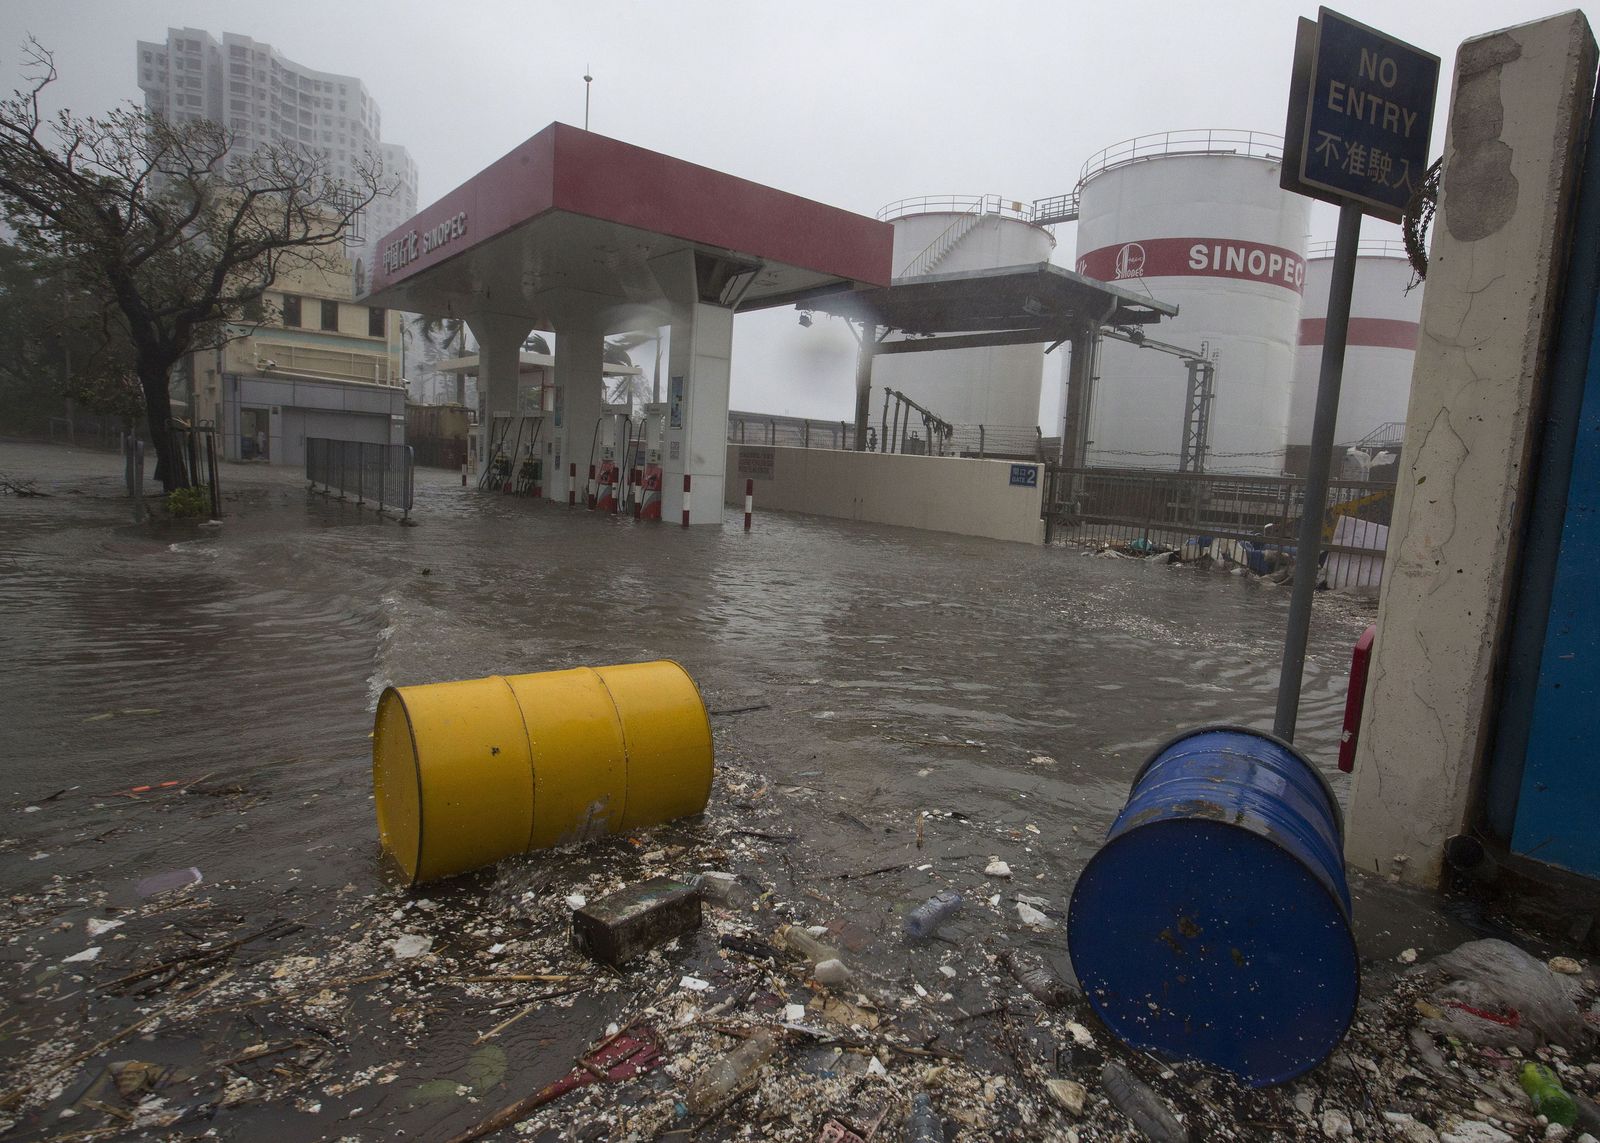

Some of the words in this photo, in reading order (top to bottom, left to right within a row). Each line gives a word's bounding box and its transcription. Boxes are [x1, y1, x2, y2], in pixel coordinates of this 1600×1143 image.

[1359, 48, 1398, 88] NO
[1328, 80, 1417, 137] ENTRY
[1314, 129, 1415, 194] 不准駛入
[423, 212, 466, 254] SINOPEC
[1188, 243, 1303, 288] SINOPEC
[1027, 469, 1036, 484] 2
